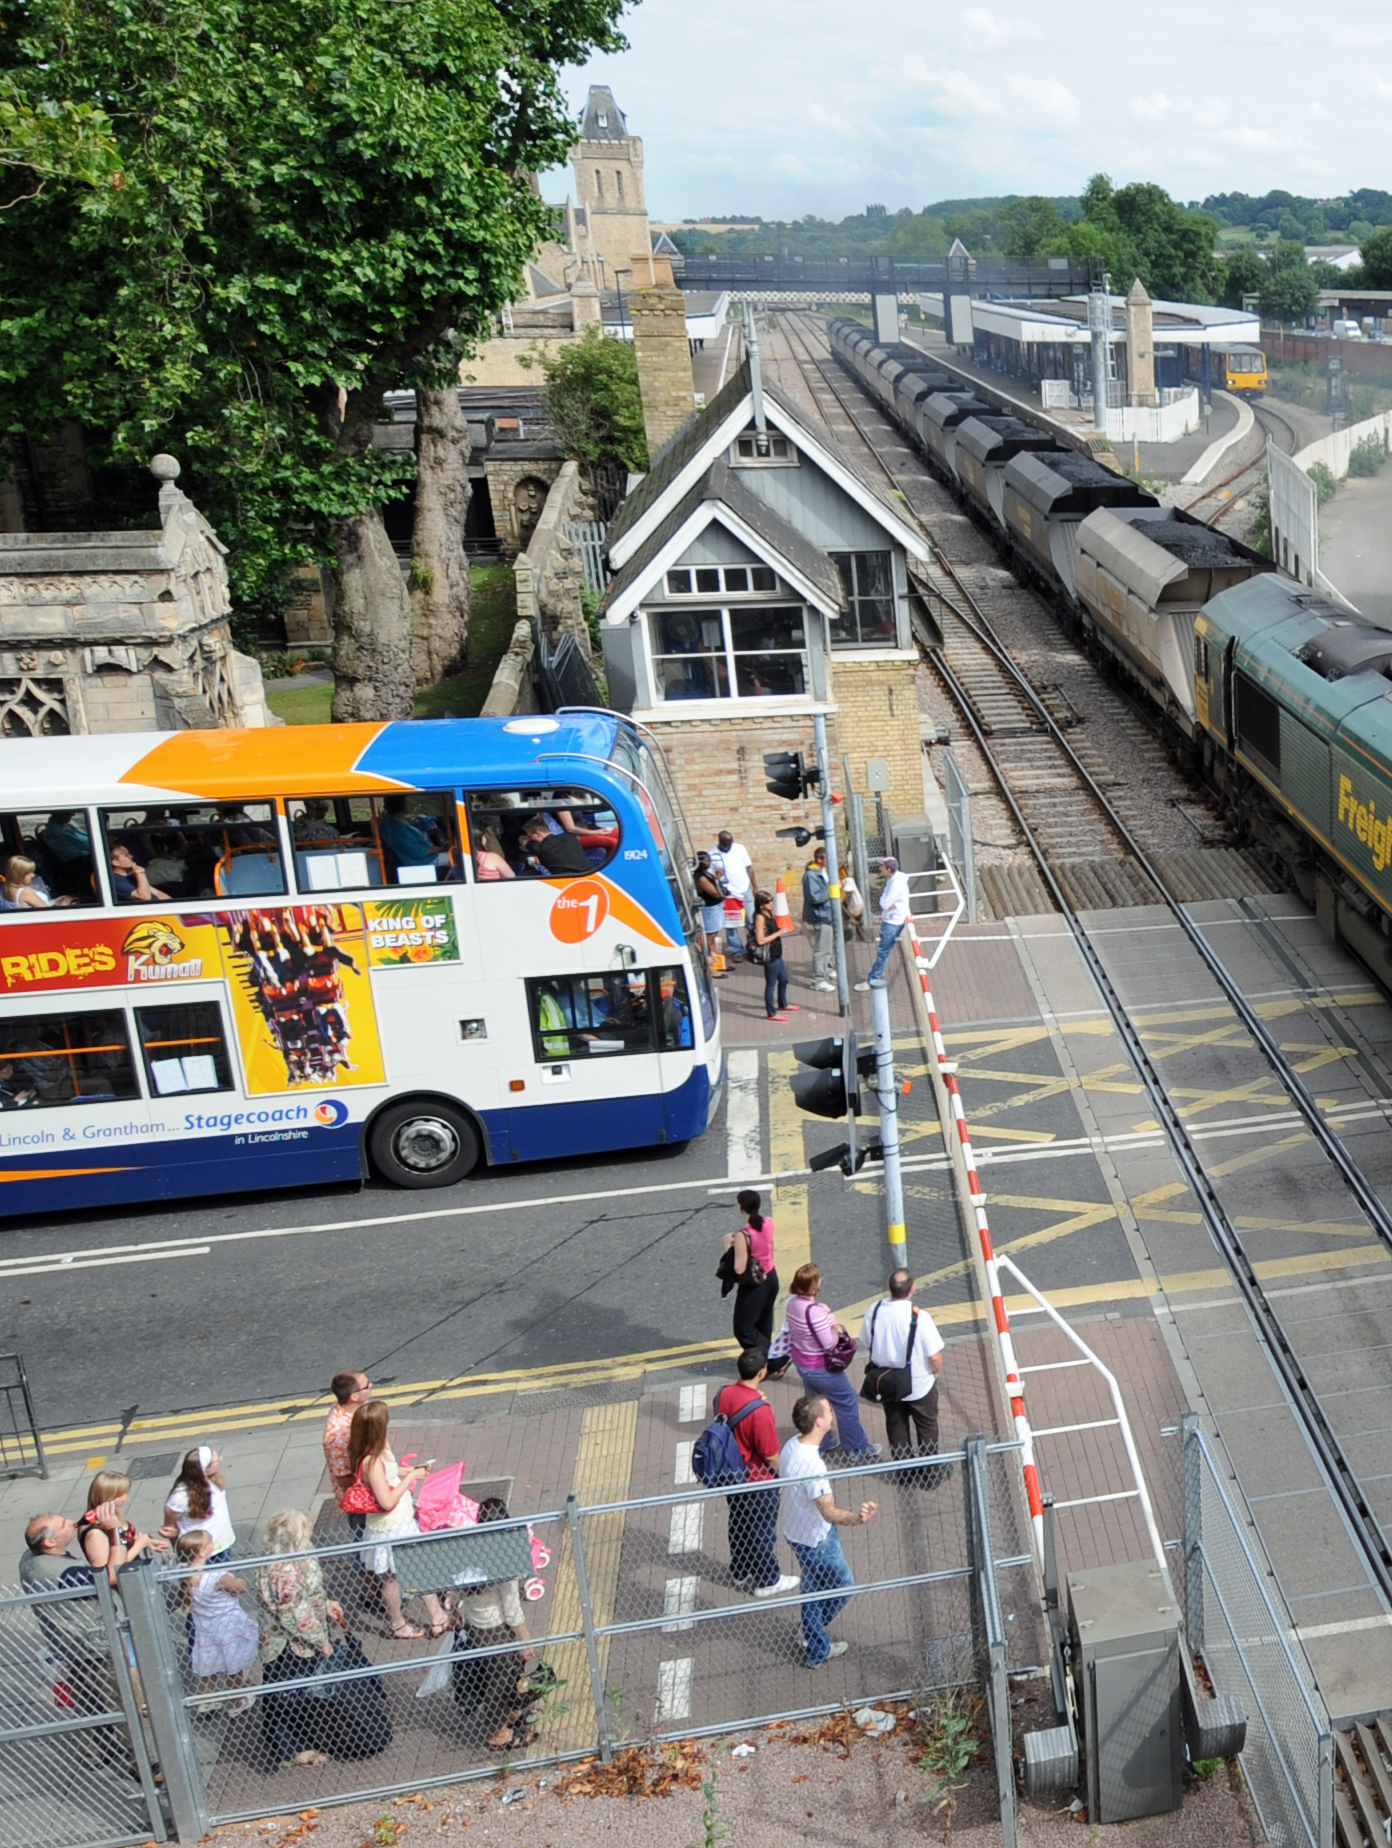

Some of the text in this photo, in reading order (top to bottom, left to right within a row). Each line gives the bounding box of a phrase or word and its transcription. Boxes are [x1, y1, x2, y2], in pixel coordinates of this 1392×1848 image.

[368, 914, 447, 932] KING OF
[556, 894, 599, 933] the 1
[371, 930, 449, 949] BEASTS
[184, 1105, 309, 1132] Stagecoach
[0, 1130, 55, 1147] Lincoln
[62, 1127, 77, 1141] &
[235, 1129, 309, 1145] in Lincolnshire
